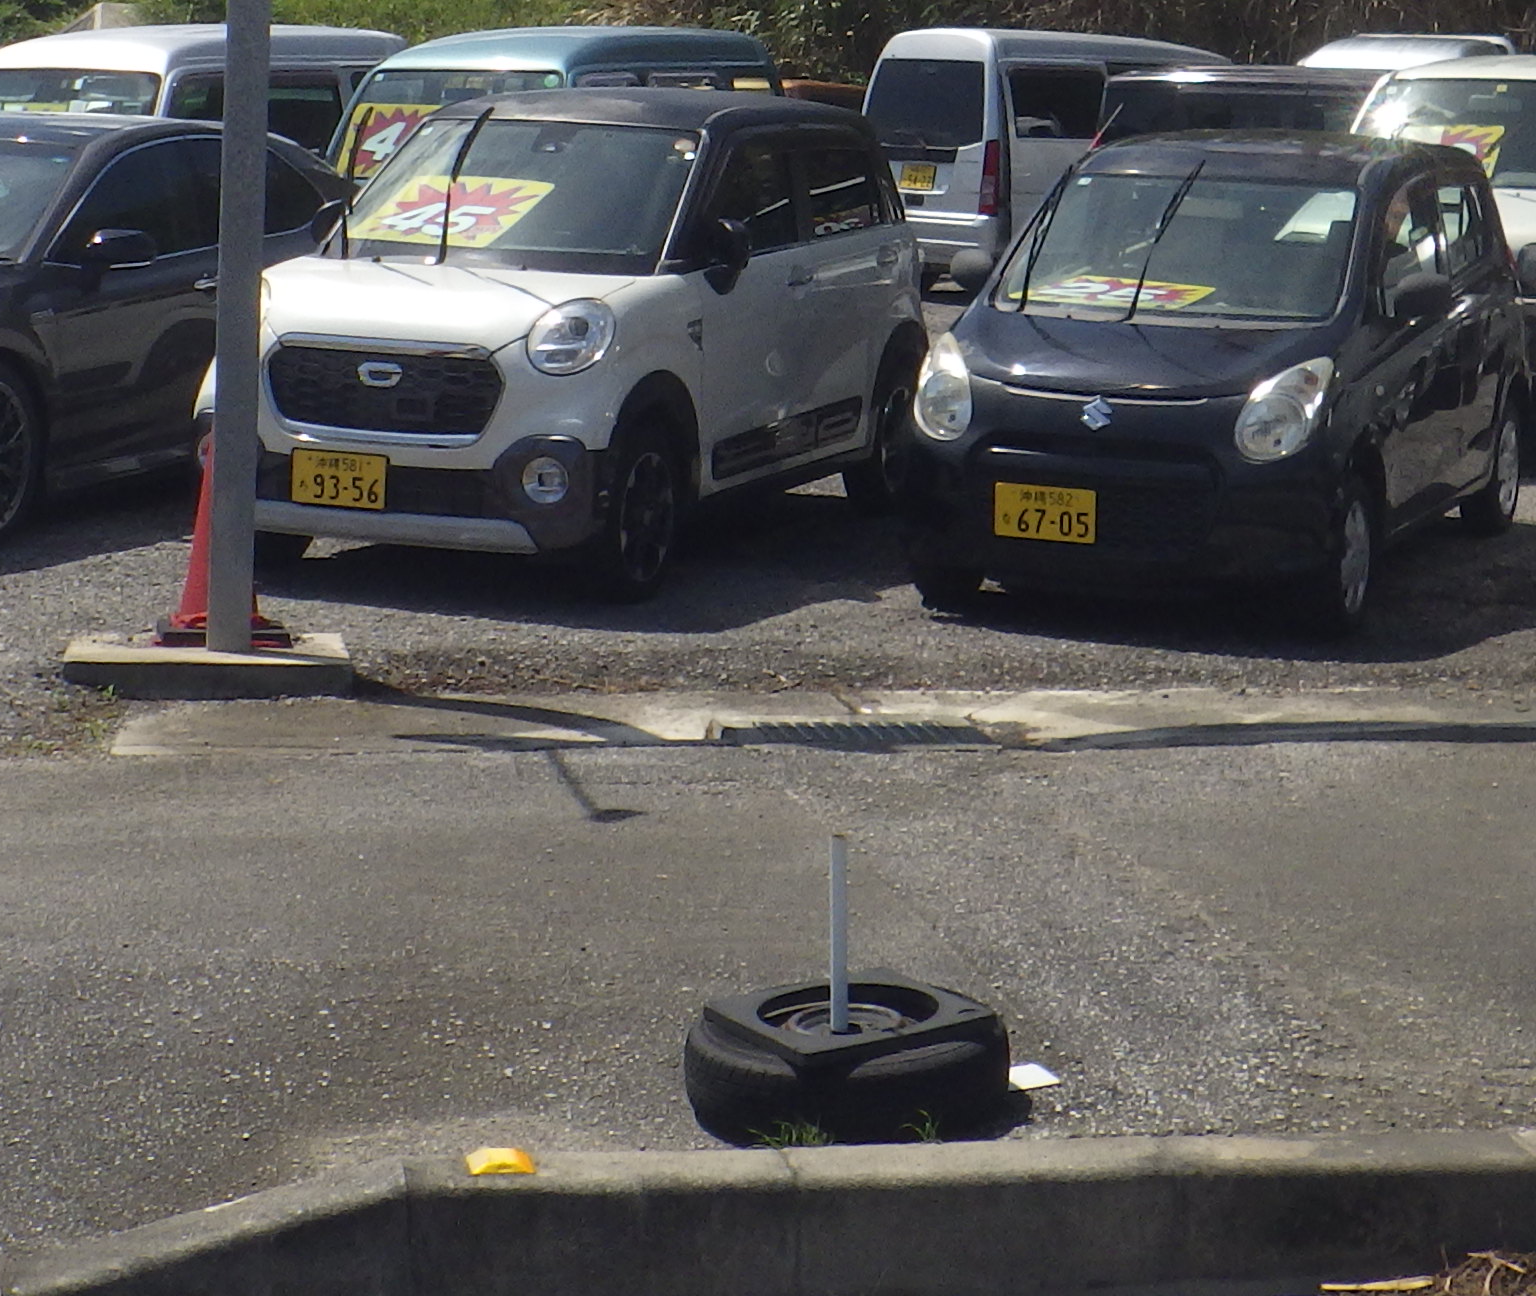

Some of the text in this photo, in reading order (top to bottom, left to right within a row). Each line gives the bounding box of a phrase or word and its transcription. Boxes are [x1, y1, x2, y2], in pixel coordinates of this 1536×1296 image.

[380, 202, 497, 236] 45
[312, 473, 379, 504] 93-56
[1016, 507, 1090, 539] 67-05
